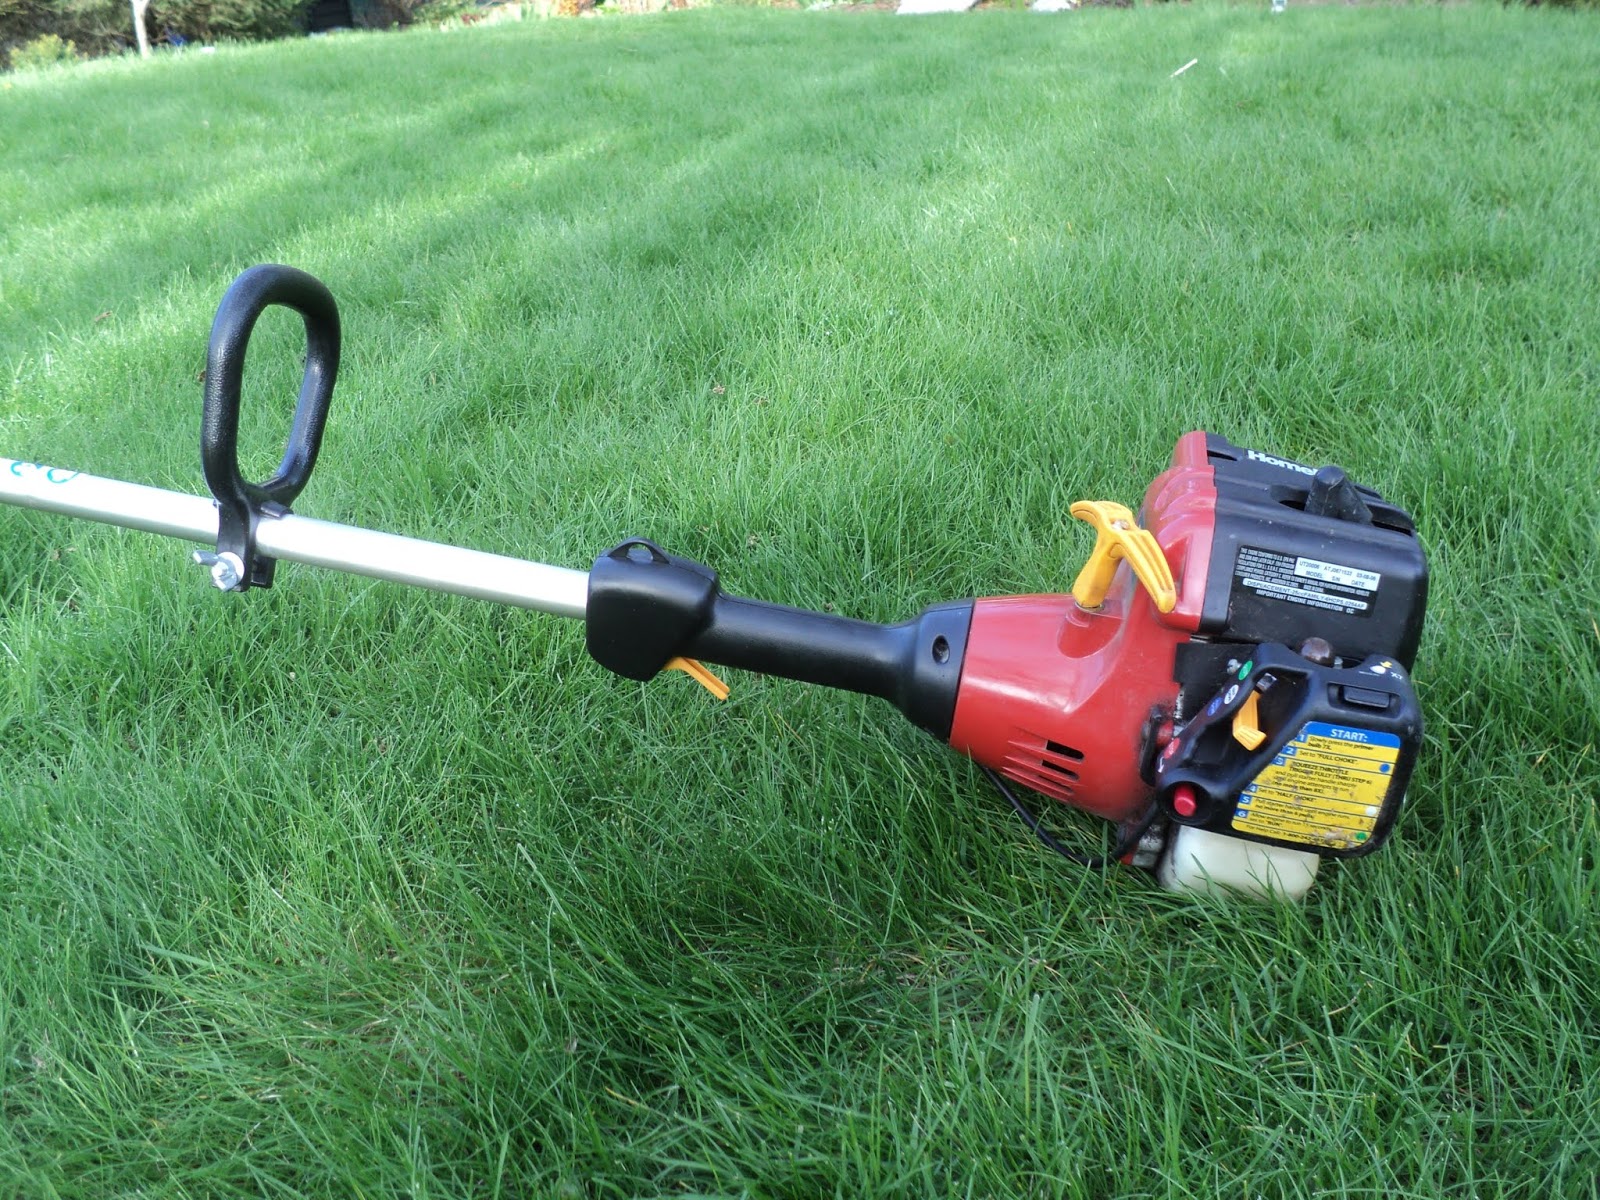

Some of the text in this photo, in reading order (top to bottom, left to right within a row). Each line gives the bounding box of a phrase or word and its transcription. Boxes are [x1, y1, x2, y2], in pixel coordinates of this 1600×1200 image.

[1306, 570, 1322, 578] MODEL
[1256, 588, 1286, 600] IMPORTANT
[1287, 594, 1306, 604] ENGINE
[1306, 598, 1343, 612] INFORMATION
[1330, 728, 1368, 742] START:
[1353, 742, 1374, 752] primer
[1276, 757, 1283, 765] 3
[1319, 765, 1348, 775] THROTTLE
[1287, 777, 1306, 786] engine
[1307, 780, 1331, 790] attempts
[1317, 776, 1336, 784] handle
[1337, 780, 1356, 788] sharply
[1285, 803, 1303, 811] handle
[1317, 809, 1336, 818] engine
[1266, 815, 1284, 823] engine
